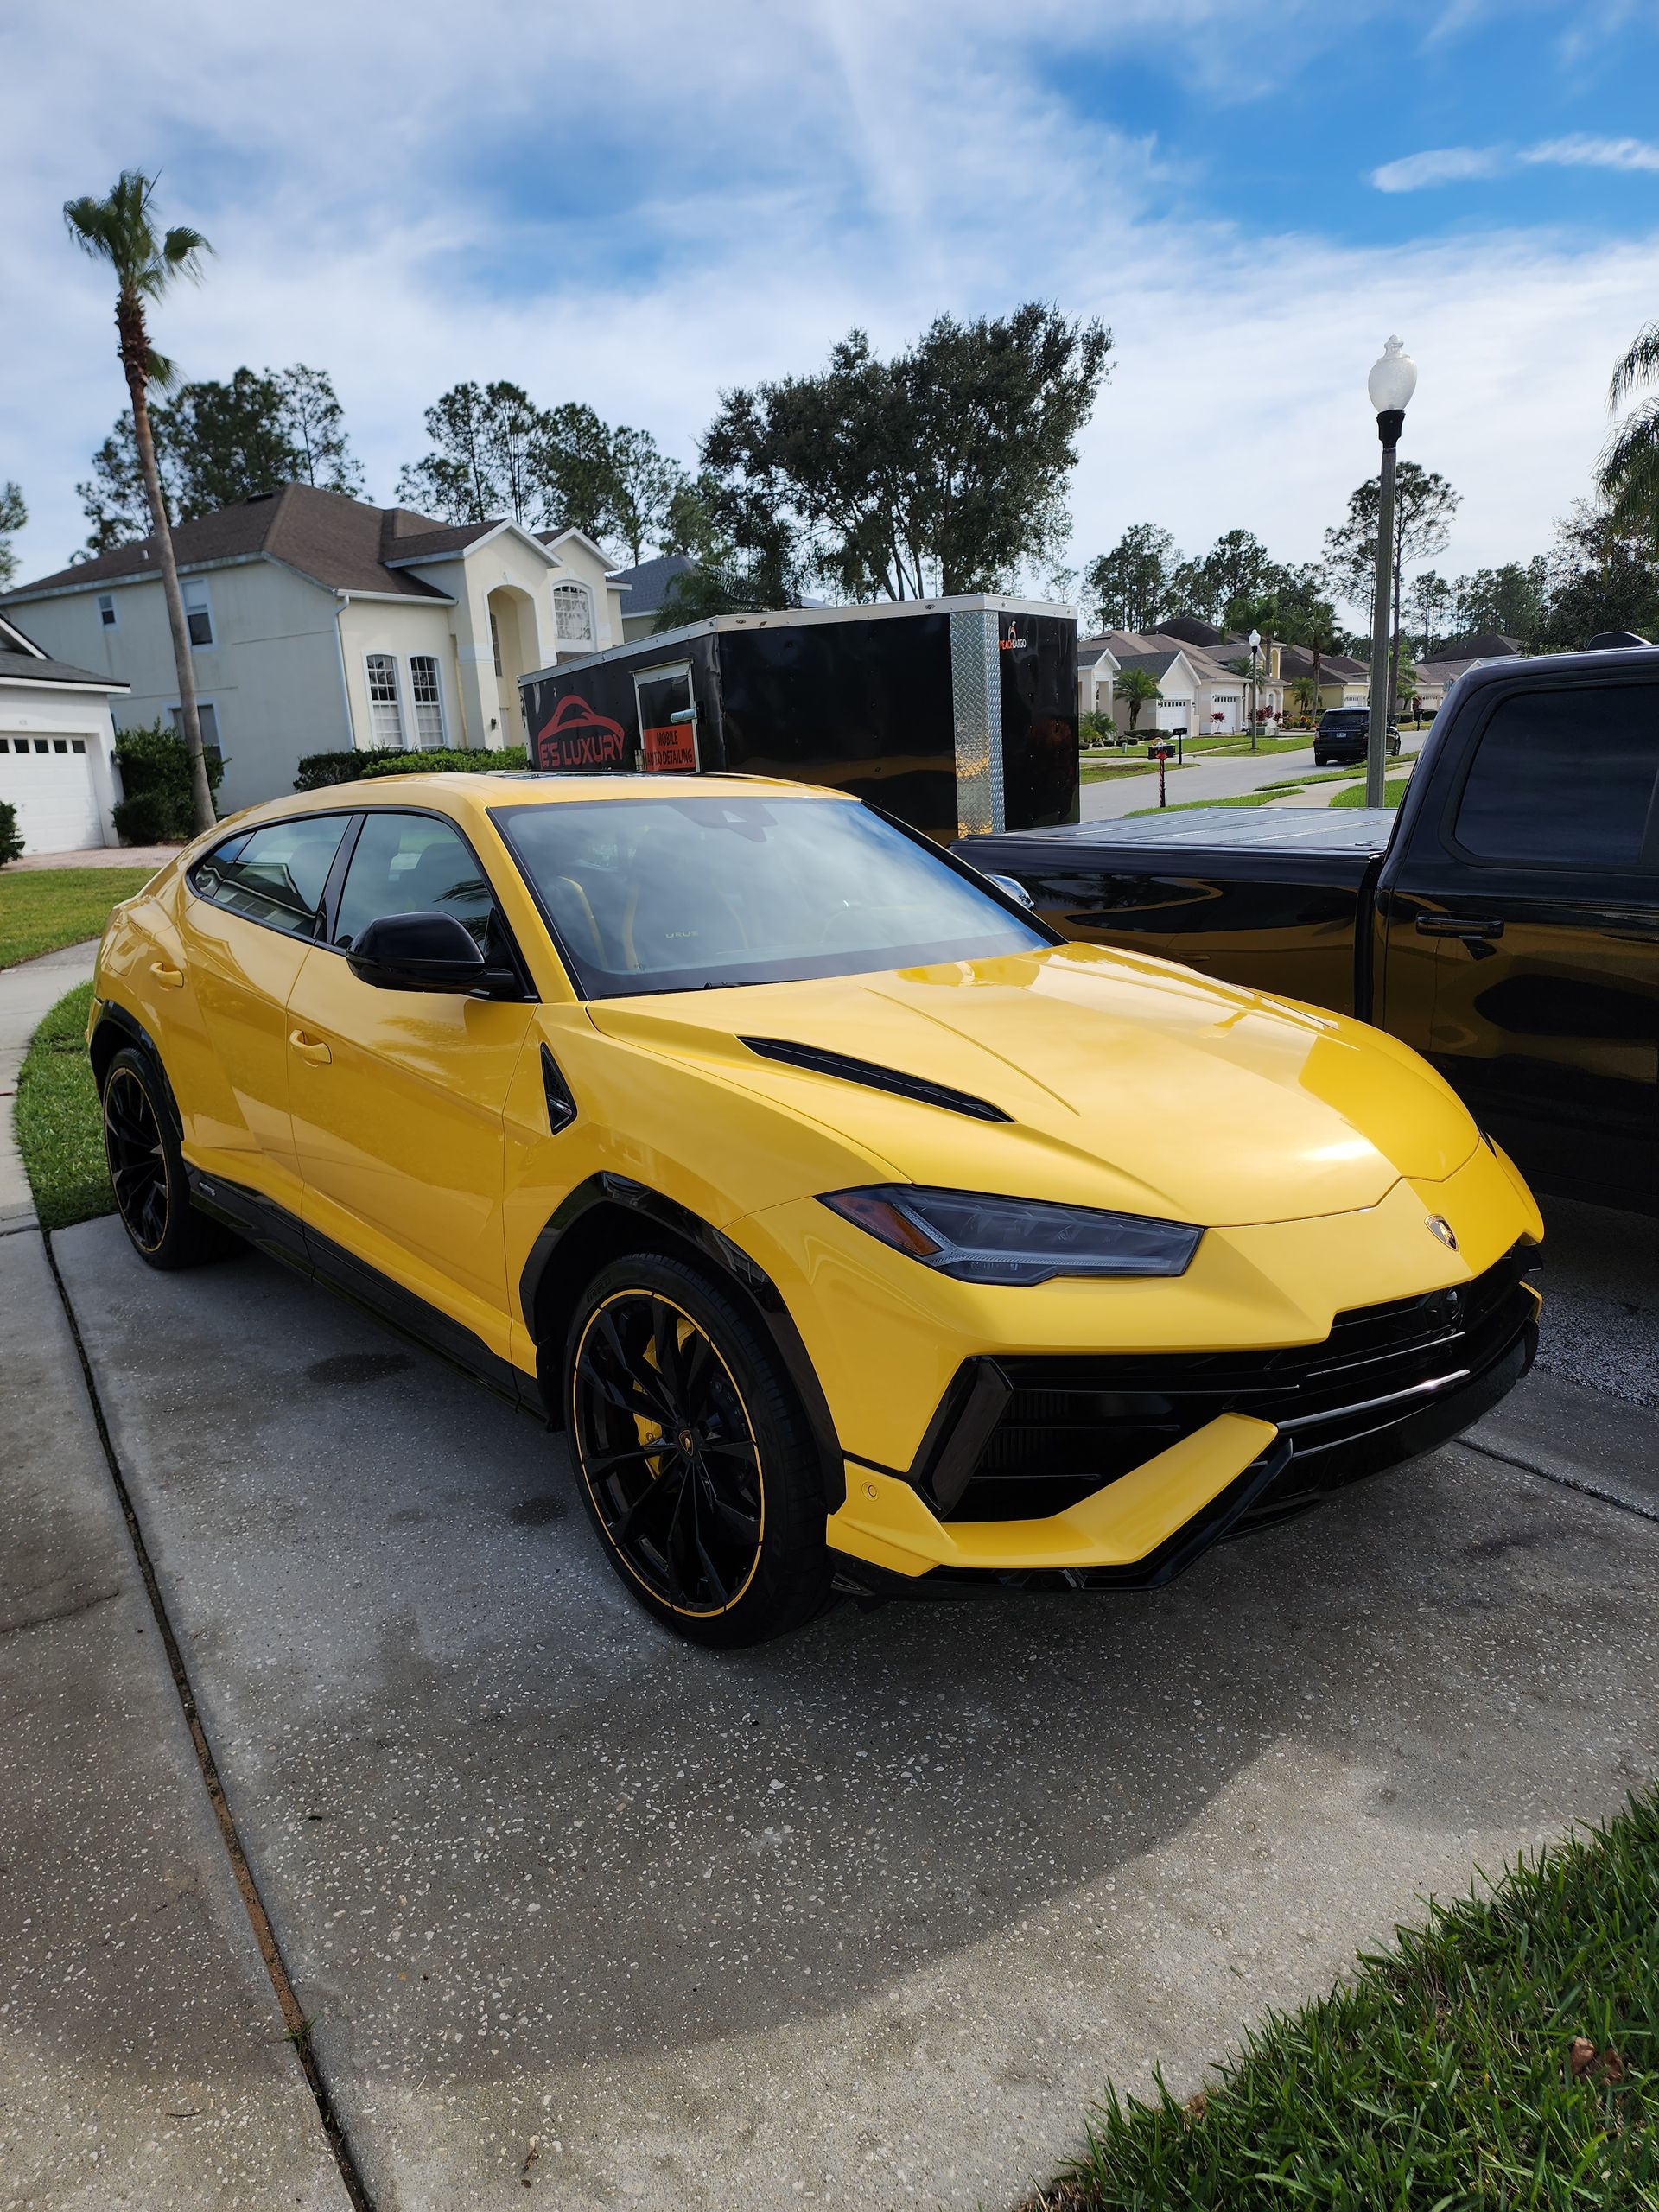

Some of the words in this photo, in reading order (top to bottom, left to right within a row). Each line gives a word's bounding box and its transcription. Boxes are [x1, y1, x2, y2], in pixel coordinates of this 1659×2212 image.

[657, 730, 678, 746] MOBILE
[563, 734, 623, 766] LUXURY
[647, 750, 662, 766] AUTO
[663, 748, 693, 765] DETAILING
